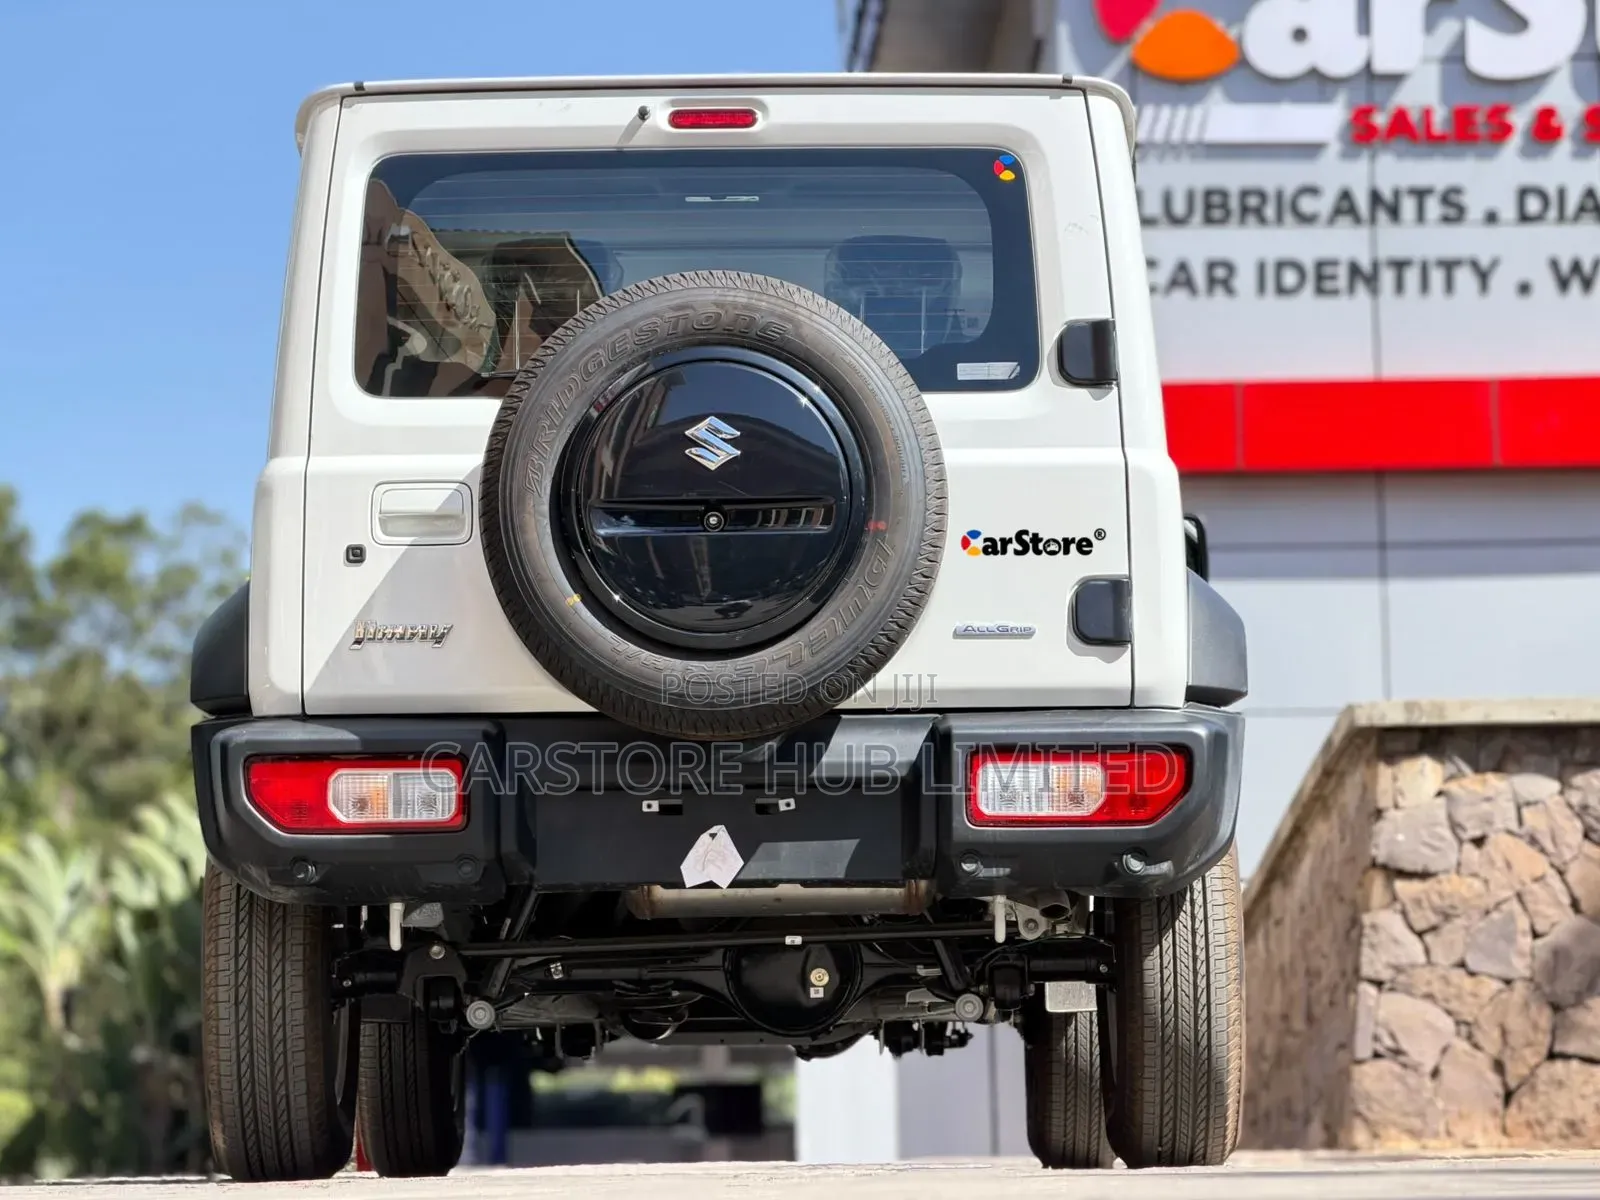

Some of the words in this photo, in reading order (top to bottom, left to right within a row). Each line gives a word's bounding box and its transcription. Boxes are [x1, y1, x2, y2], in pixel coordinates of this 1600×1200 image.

[1350, 104, 1515, 144] SALES
[1136, 185, 1466, 226] LUBRICANTS
[1257, 257, 1501, 297] IDENTITY
